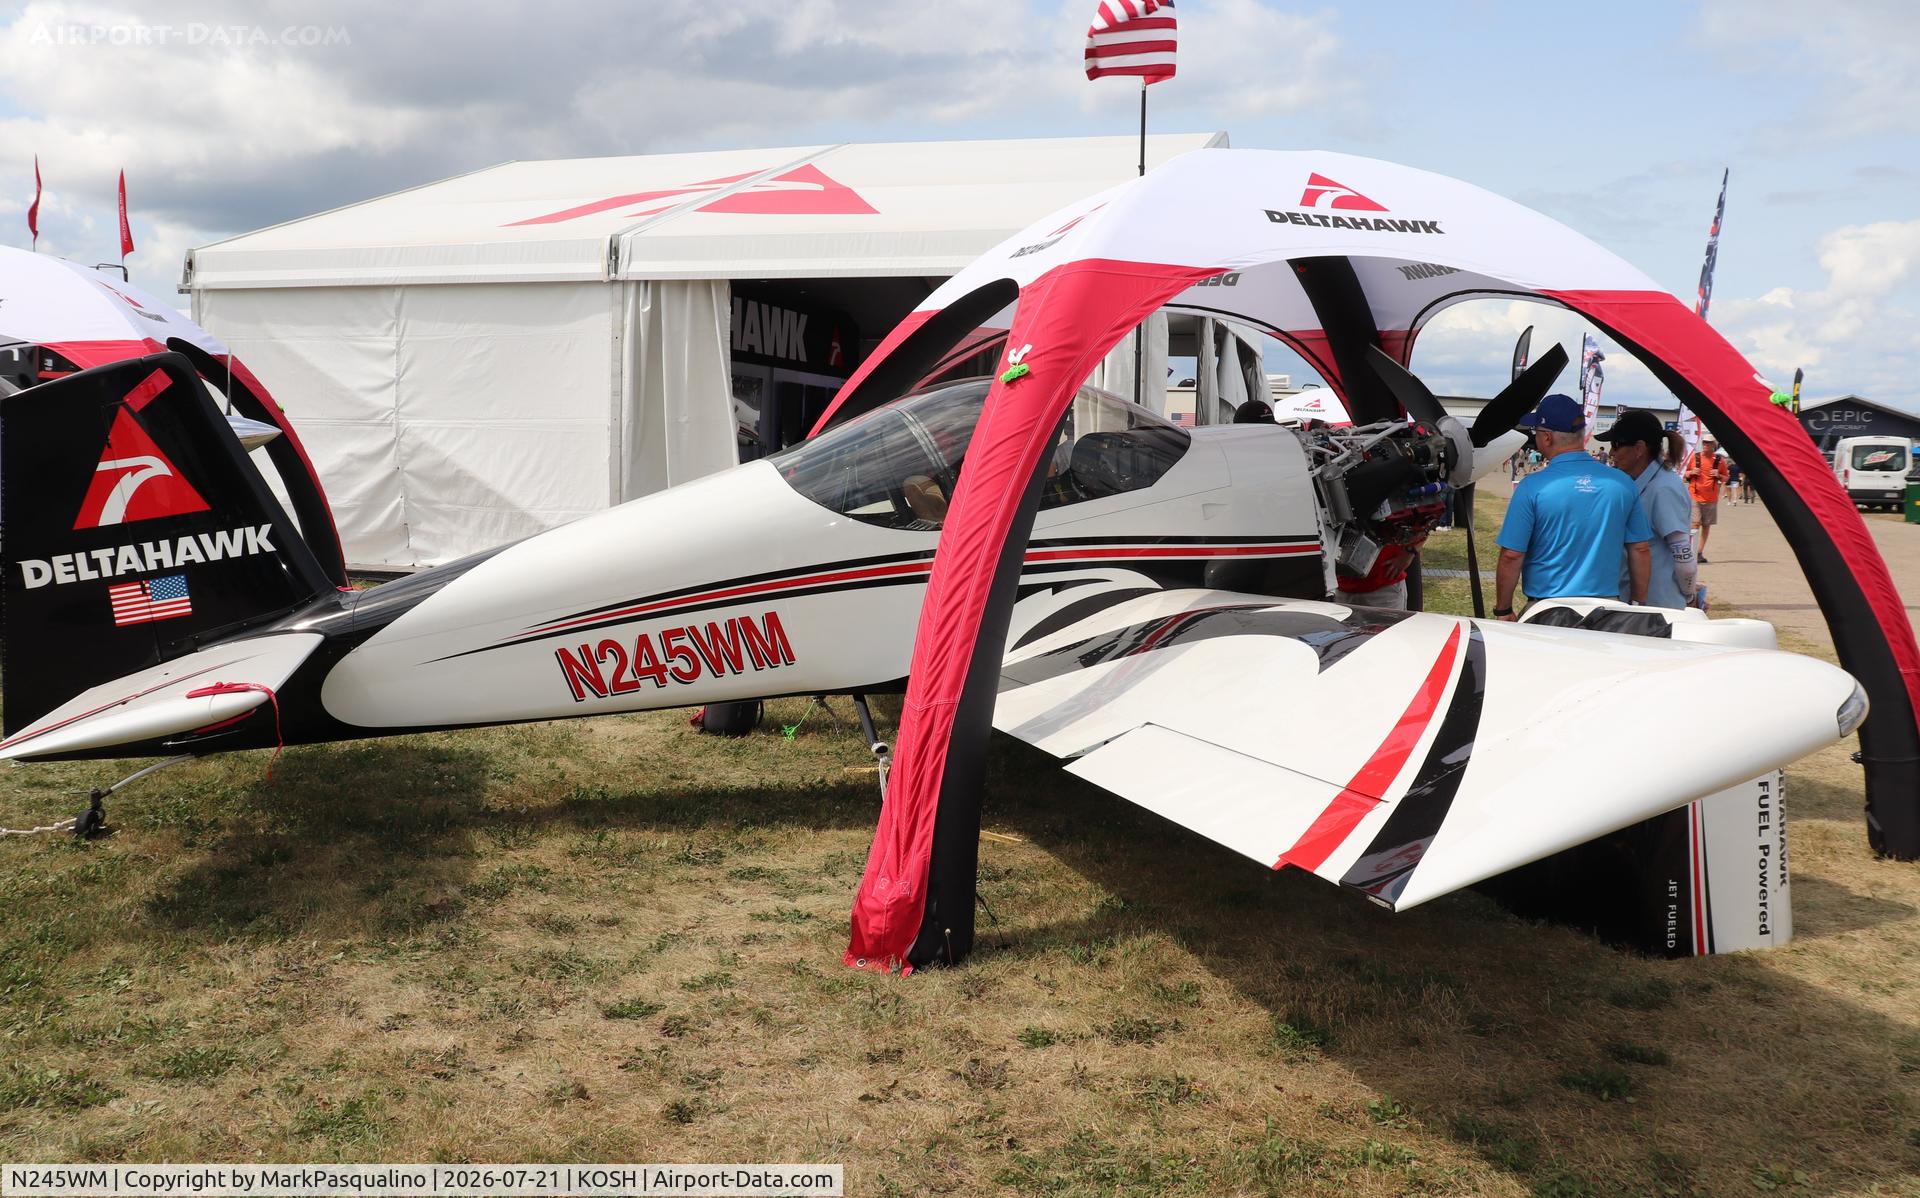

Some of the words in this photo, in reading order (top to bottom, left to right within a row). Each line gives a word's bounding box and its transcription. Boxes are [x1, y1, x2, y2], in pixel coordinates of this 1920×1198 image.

[1262, 208, 1446, 235] DELTAHAWK
[1831, 410, 1873, 423] EPIC
[16, 523, 277, 590] DELTAHAWK
[555, 611, 796, 702] N245WM
[1758, 781, 1770, 838] FUEL
[1668, 879, 1678, 899] JET
[1758, 844, 1771, 936] Powered
[1667, 904, 1677, 949] FUELED
